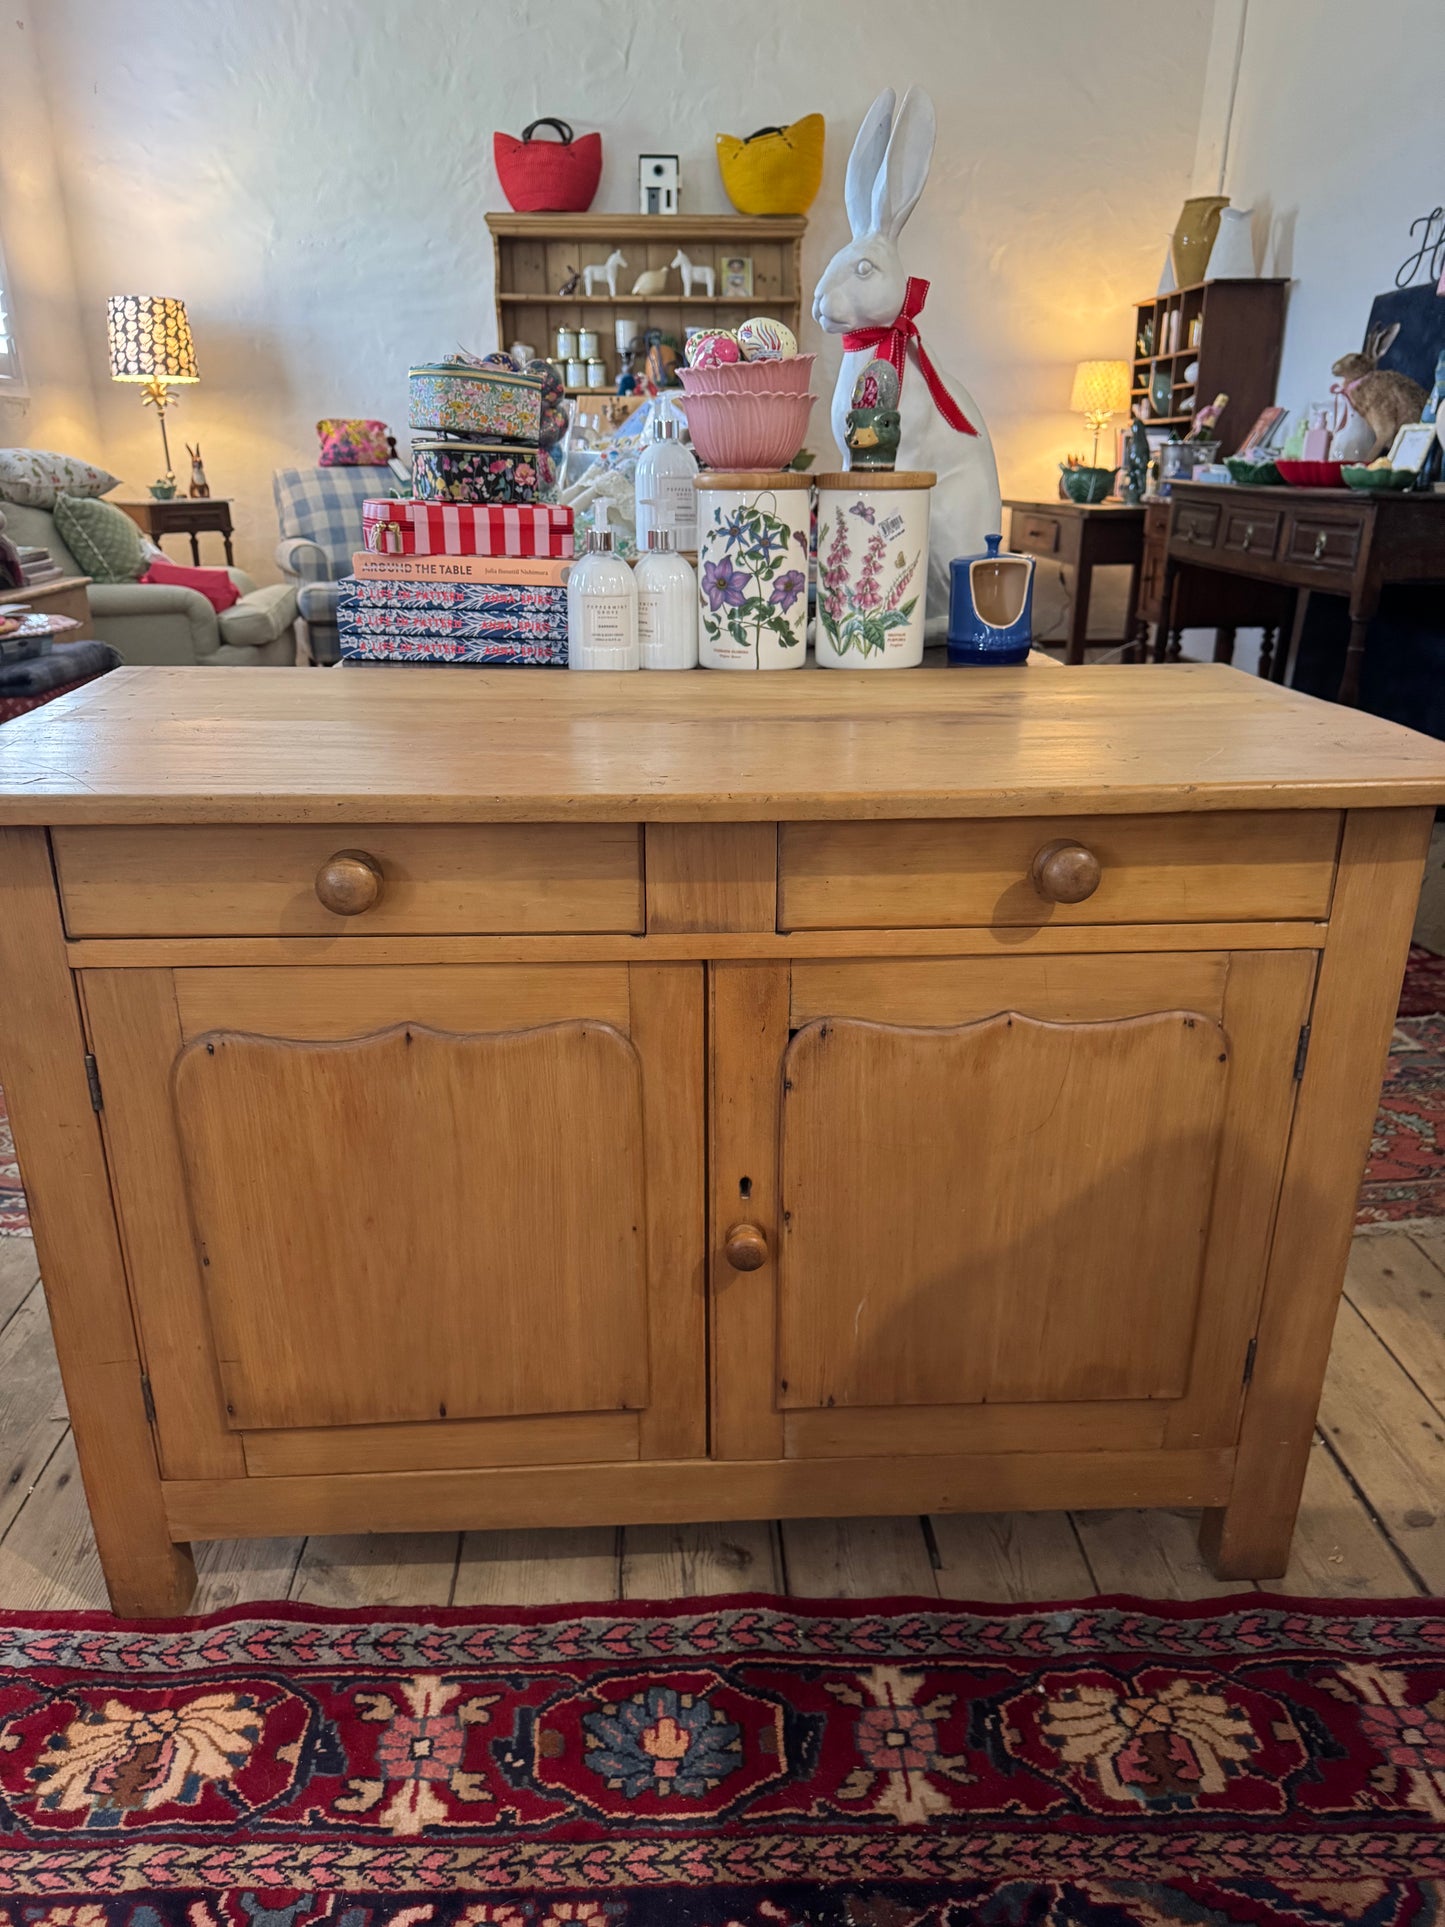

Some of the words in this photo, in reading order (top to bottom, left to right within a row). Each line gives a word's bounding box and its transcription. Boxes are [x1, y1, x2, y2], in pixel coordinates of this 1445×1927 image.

[362, 562, 412, 574] AROUND
[415, 564, 437, 574] THE
[439, 565, 472, 576] TABLE
[357, 588, 364, 598] A
[370, 589, 392, 600] LIFE
[398, 591, 410, 600] IN
[416, 591, 464, 602] PATTERN
[484, 594, 515, 604] ANNA
[521, 594, 553, 604] SPIRO
[355, 615, 362, 626] A
[368, 616, 391, 626] LIFE
[396, 617, 408, 627] IN
[414, 618, 462, 629] PATTERN
[482, 620, 512, 630] ANNA
[518, 621, 550, 632] SPIRO
[360, 641, 368, 651] A
[372, 642, 395, 652] LIFE
[400, 643, 412, 652] IN
[418, 644, 465, 654] PATTERN
[485, 646, 516, 656] ANNA
[521, 646, 553, 657] SPIRO
